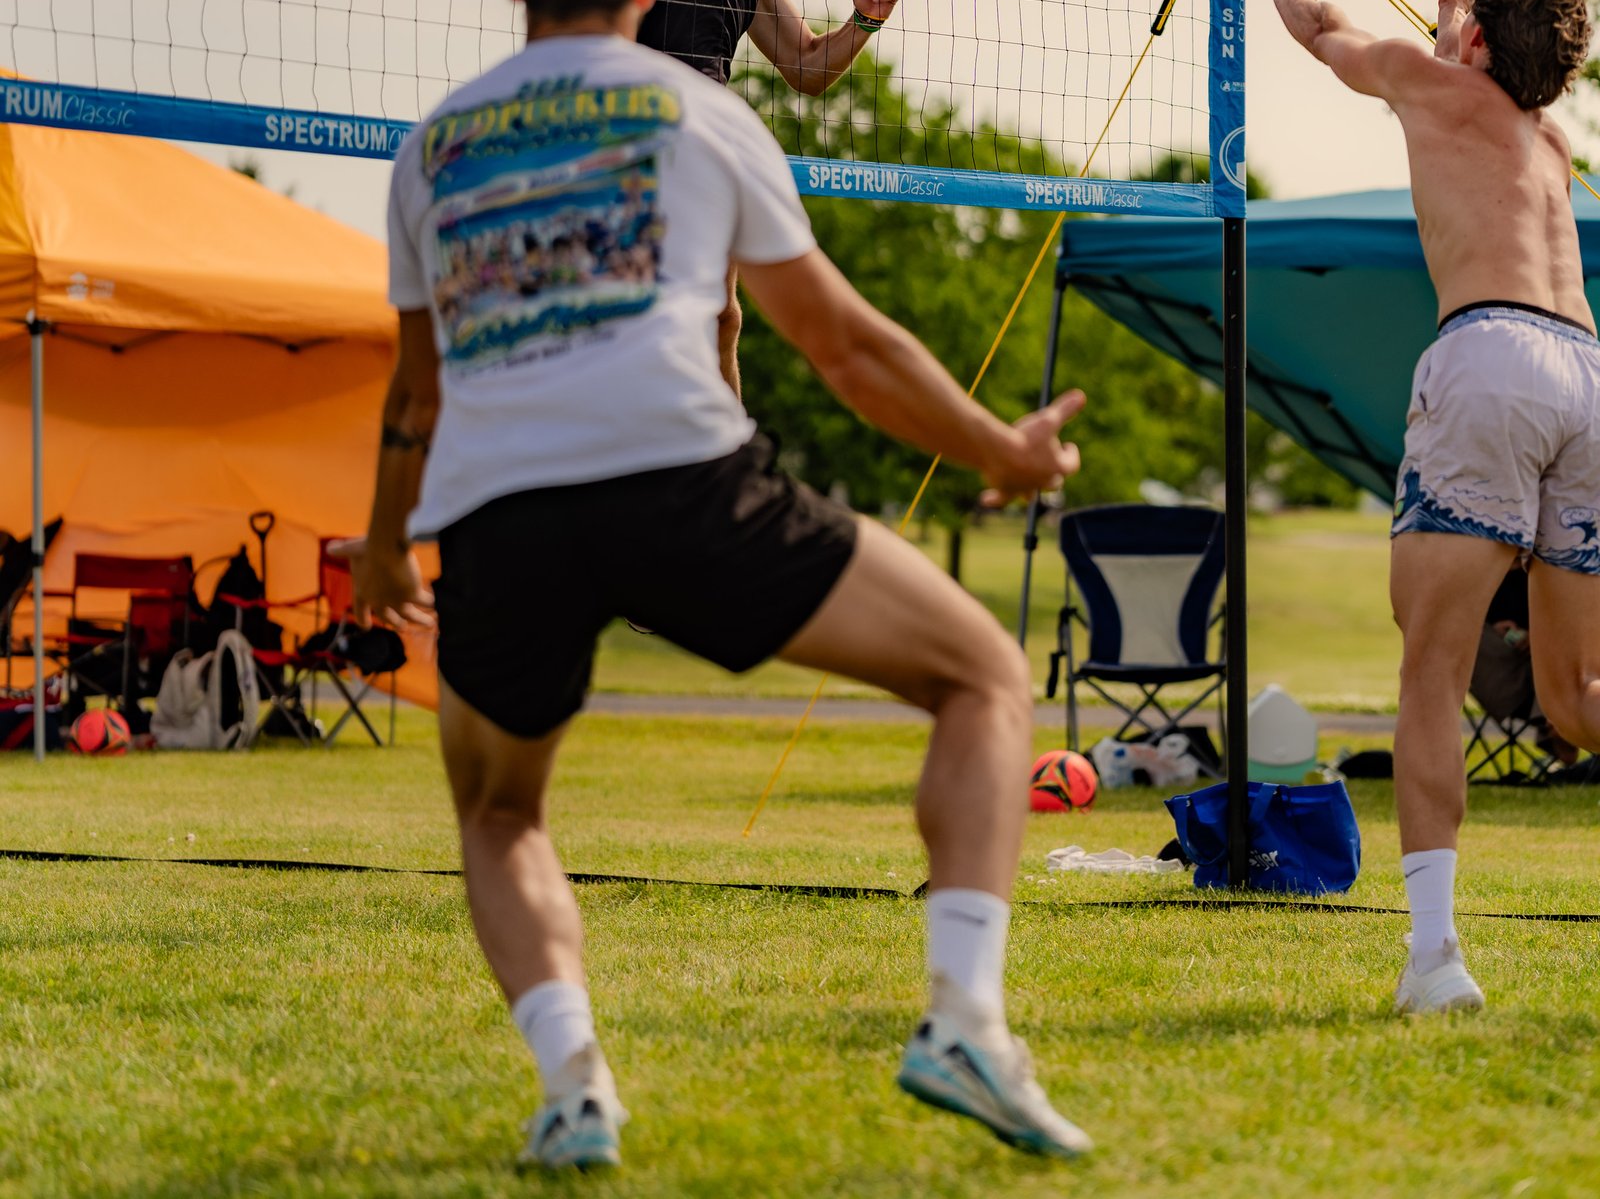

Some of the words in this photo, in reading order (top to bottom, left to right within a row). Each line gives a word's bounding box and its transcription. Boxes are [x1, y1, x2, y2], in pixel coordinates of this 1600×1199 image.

[1222, 8, 1235, 58] SUN
[0, 85, 62, 119] RUM
[63, 94, 137, 128] Classic
[265, 114, 388, 152] SPECTRUM
[808, 165, 899, 194] SPECTRUM
[899, 173, 946, 198] Classic
[1025, 180, 1103, 207] SPECTRUM
[1103, 186, 1143, 209] Classic
[1249, 850, 1279, 871] ijer
